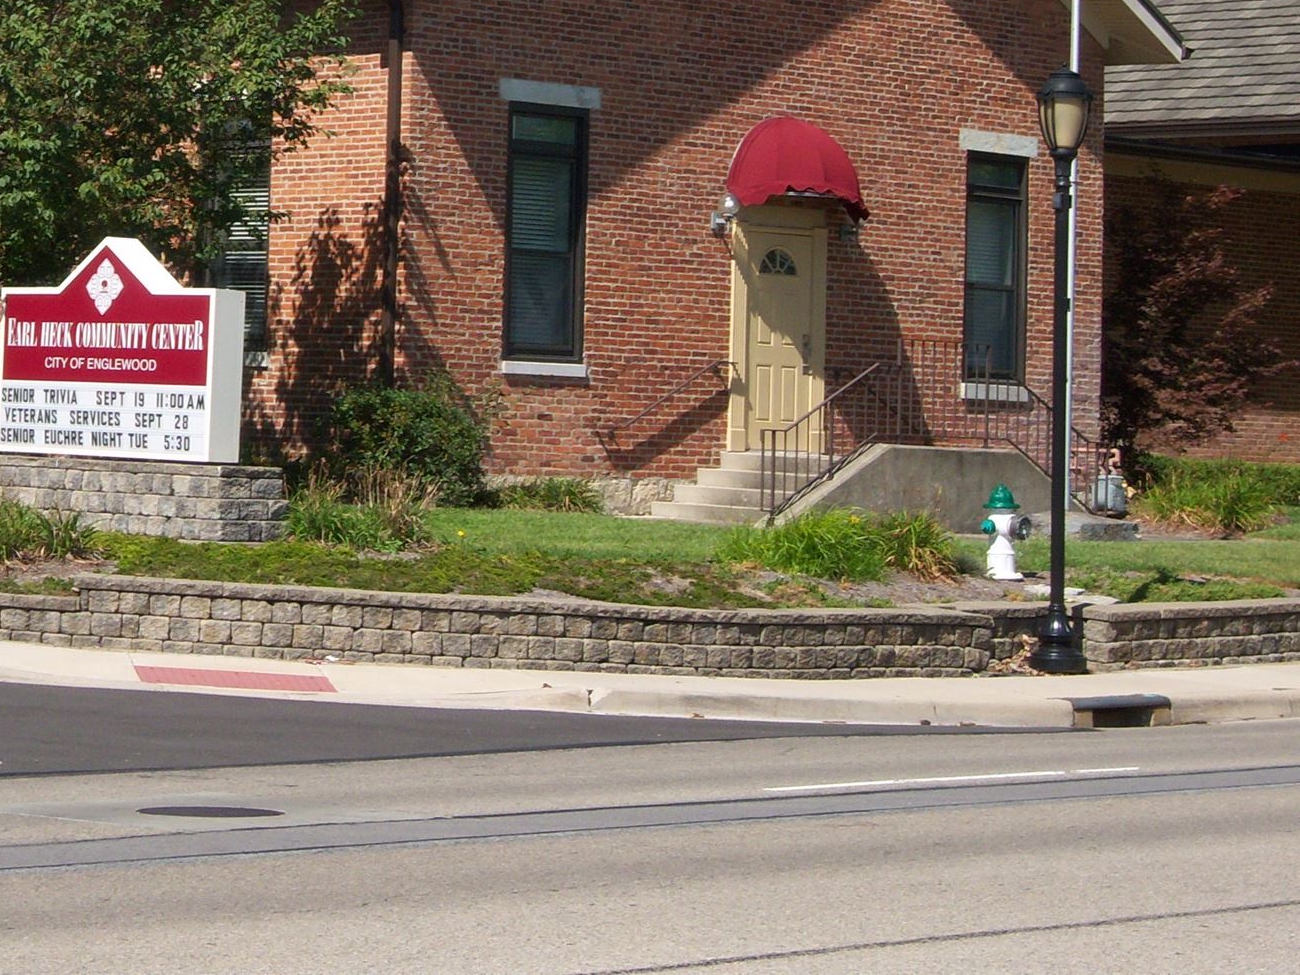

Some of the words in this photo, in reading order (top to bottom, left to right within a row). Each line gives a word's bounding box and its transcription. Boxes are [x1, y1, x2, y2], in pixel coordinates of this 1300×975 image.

[7, 317, 38, 347] EARL
[40, 321, 73, 348] HECK
[75, 322, 151, 350] COMMUNITY
[152, 319, 204, 351] CENTER
[44, 356, 68, 369] CITY
[69, 357, 85, 370] OF
[87, 357, 157, 371] ENGLEWOOD
[1, 387, 35, 403] SENIOR
[43, 388, 78, 405] TRIVIA
[96, 390, 126, 406] SEPT
[134, 391, 145, 407] 19
[4, 407, 58, 424] VETERANS
[69, 410, 121, 427] SERVICES
[135, 412, 163, 428] SEPT
[174, 414, 189, 430] 28
[0, 427, 35, 444] SENIOR
[44, 429, 84, 446] EUCHRE
[91, 431, 123, 447] NIGHT
[128, 432, 148, 449] TUE
[164, 434, 190, 452] 5:30
